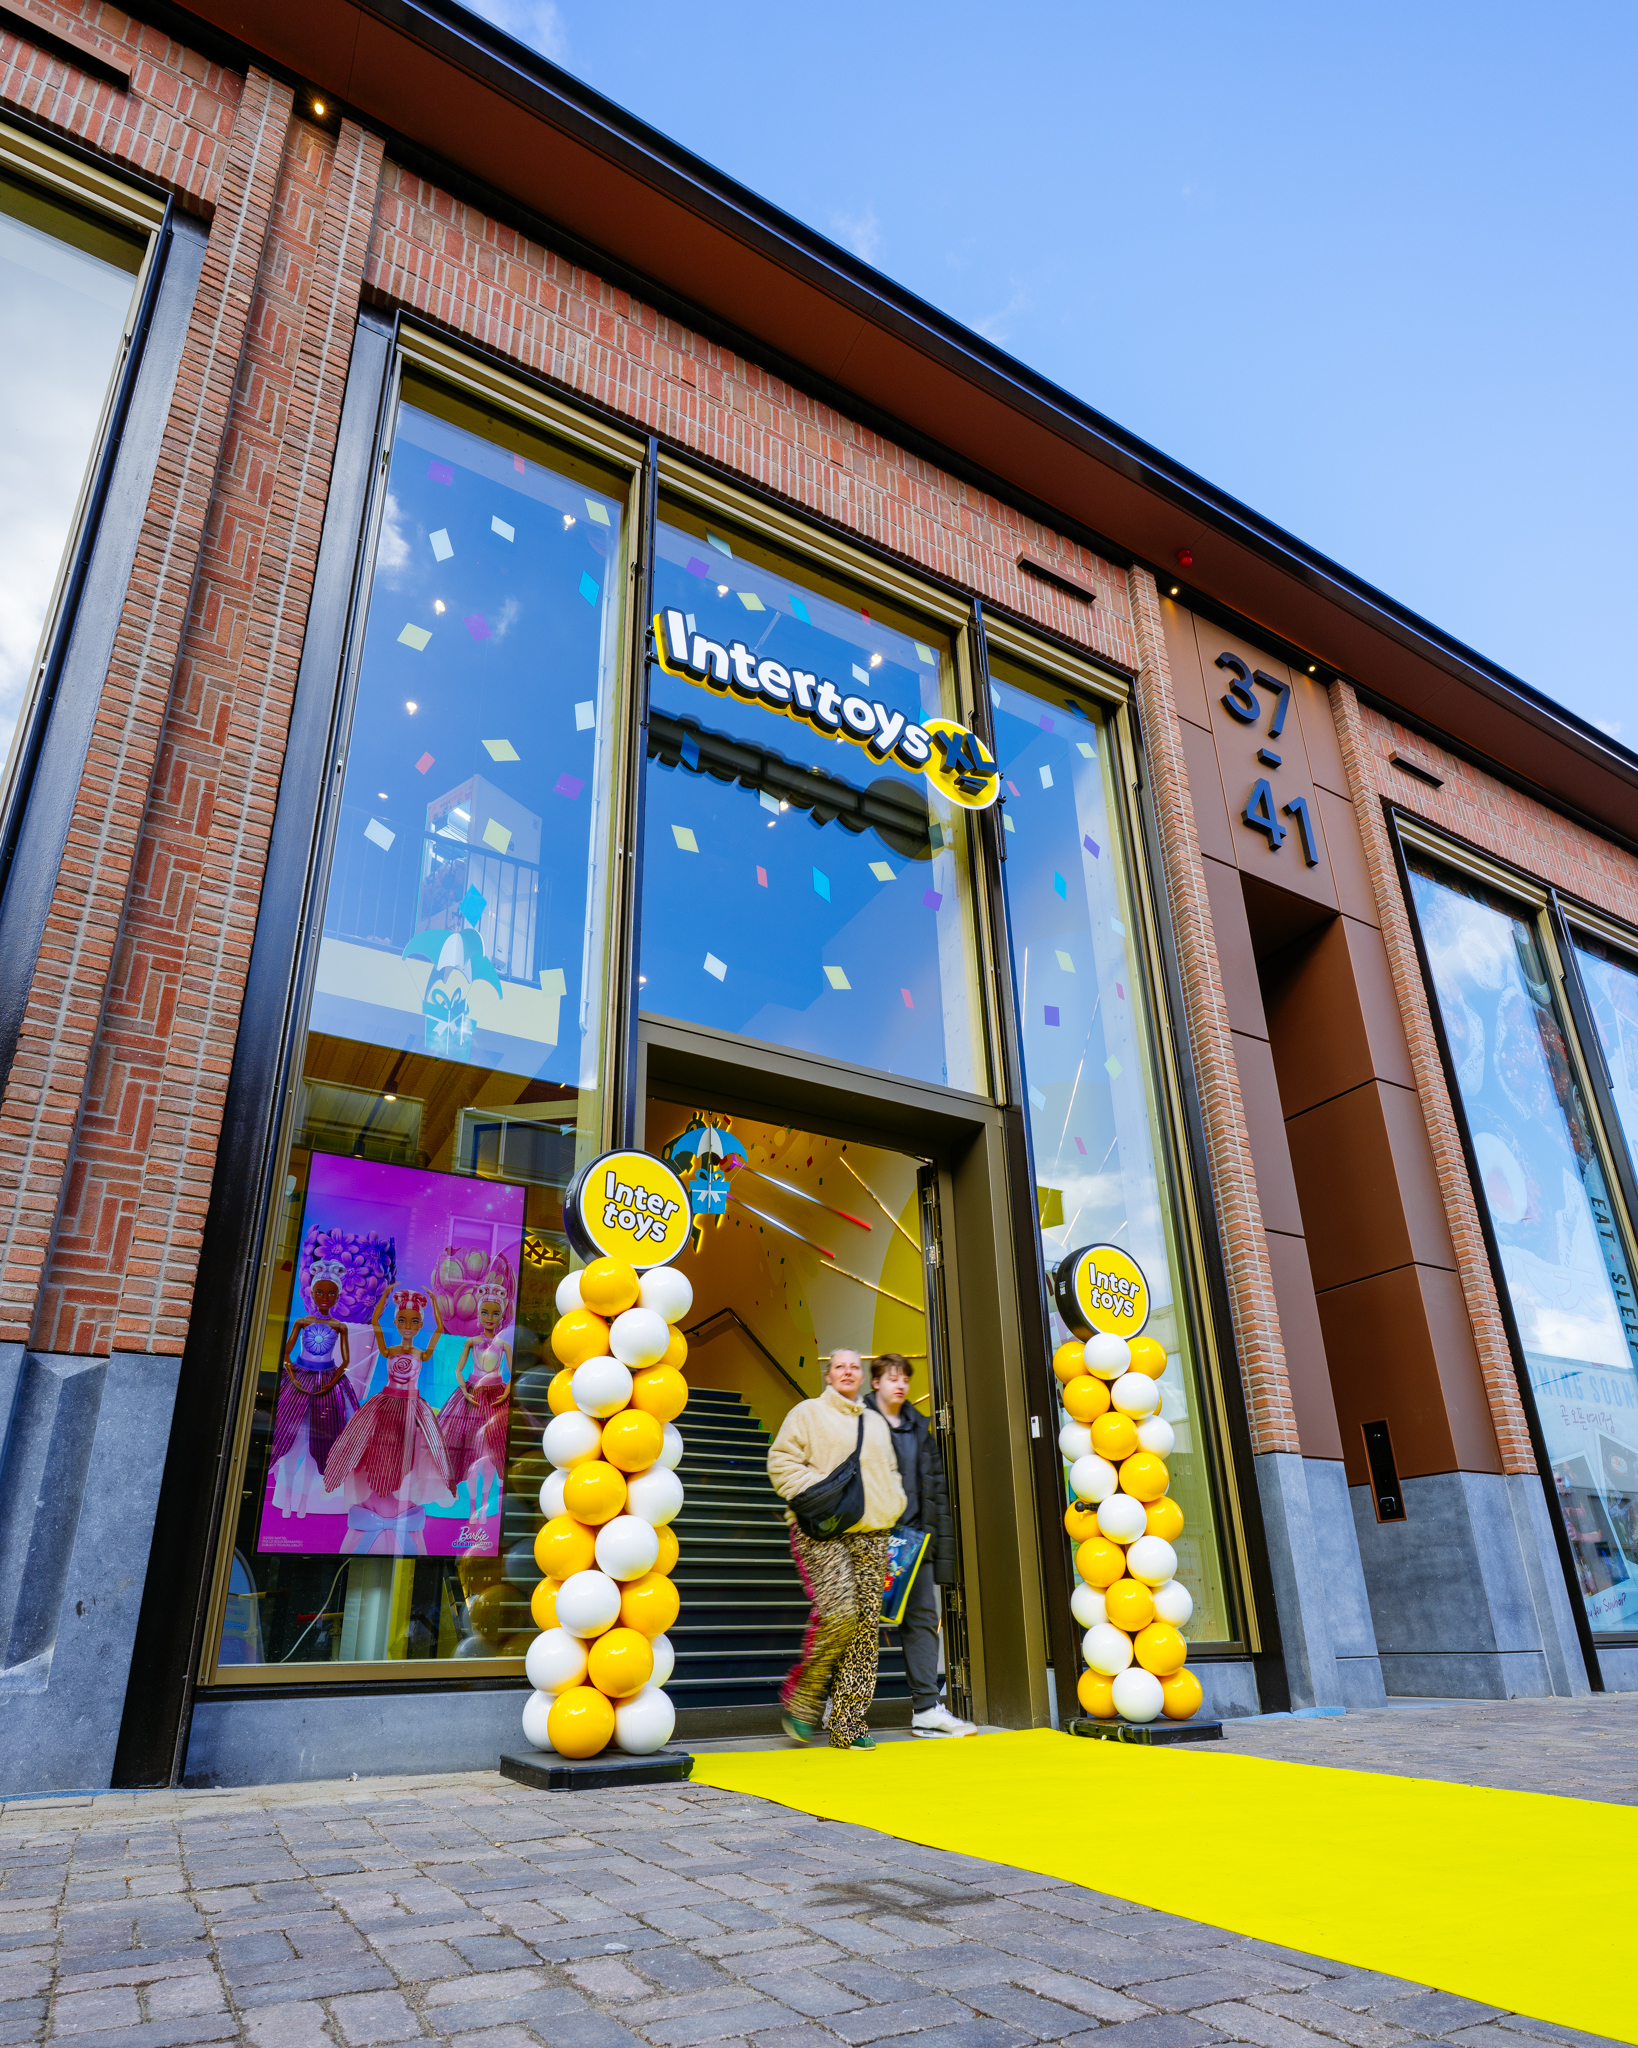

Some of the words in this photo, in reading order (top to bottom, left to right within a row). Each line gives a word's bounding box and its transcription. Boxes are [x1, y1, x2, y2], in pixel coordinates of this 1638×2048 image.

[660, 606, 933, 766] Intertoys
[932, 729, 998, 777] XL
[1214, 652, 1291, 739] 37
[1241, 778, 1319, 868] 41
[604, 1170, 680, 1221] Inter
[603, 1202, 668, 1243] toys
[1590, 1196, 1616, 1243] EAT
[1088, 1261, 1140, 1300] Inter
[1091, 1286, 1135, 1318] toys
[1527, 1363, 1584, 1401] OMING
[1589, 1374, 1635, 1409] SOON
[459, 1525, 490, 1542] Barbie
